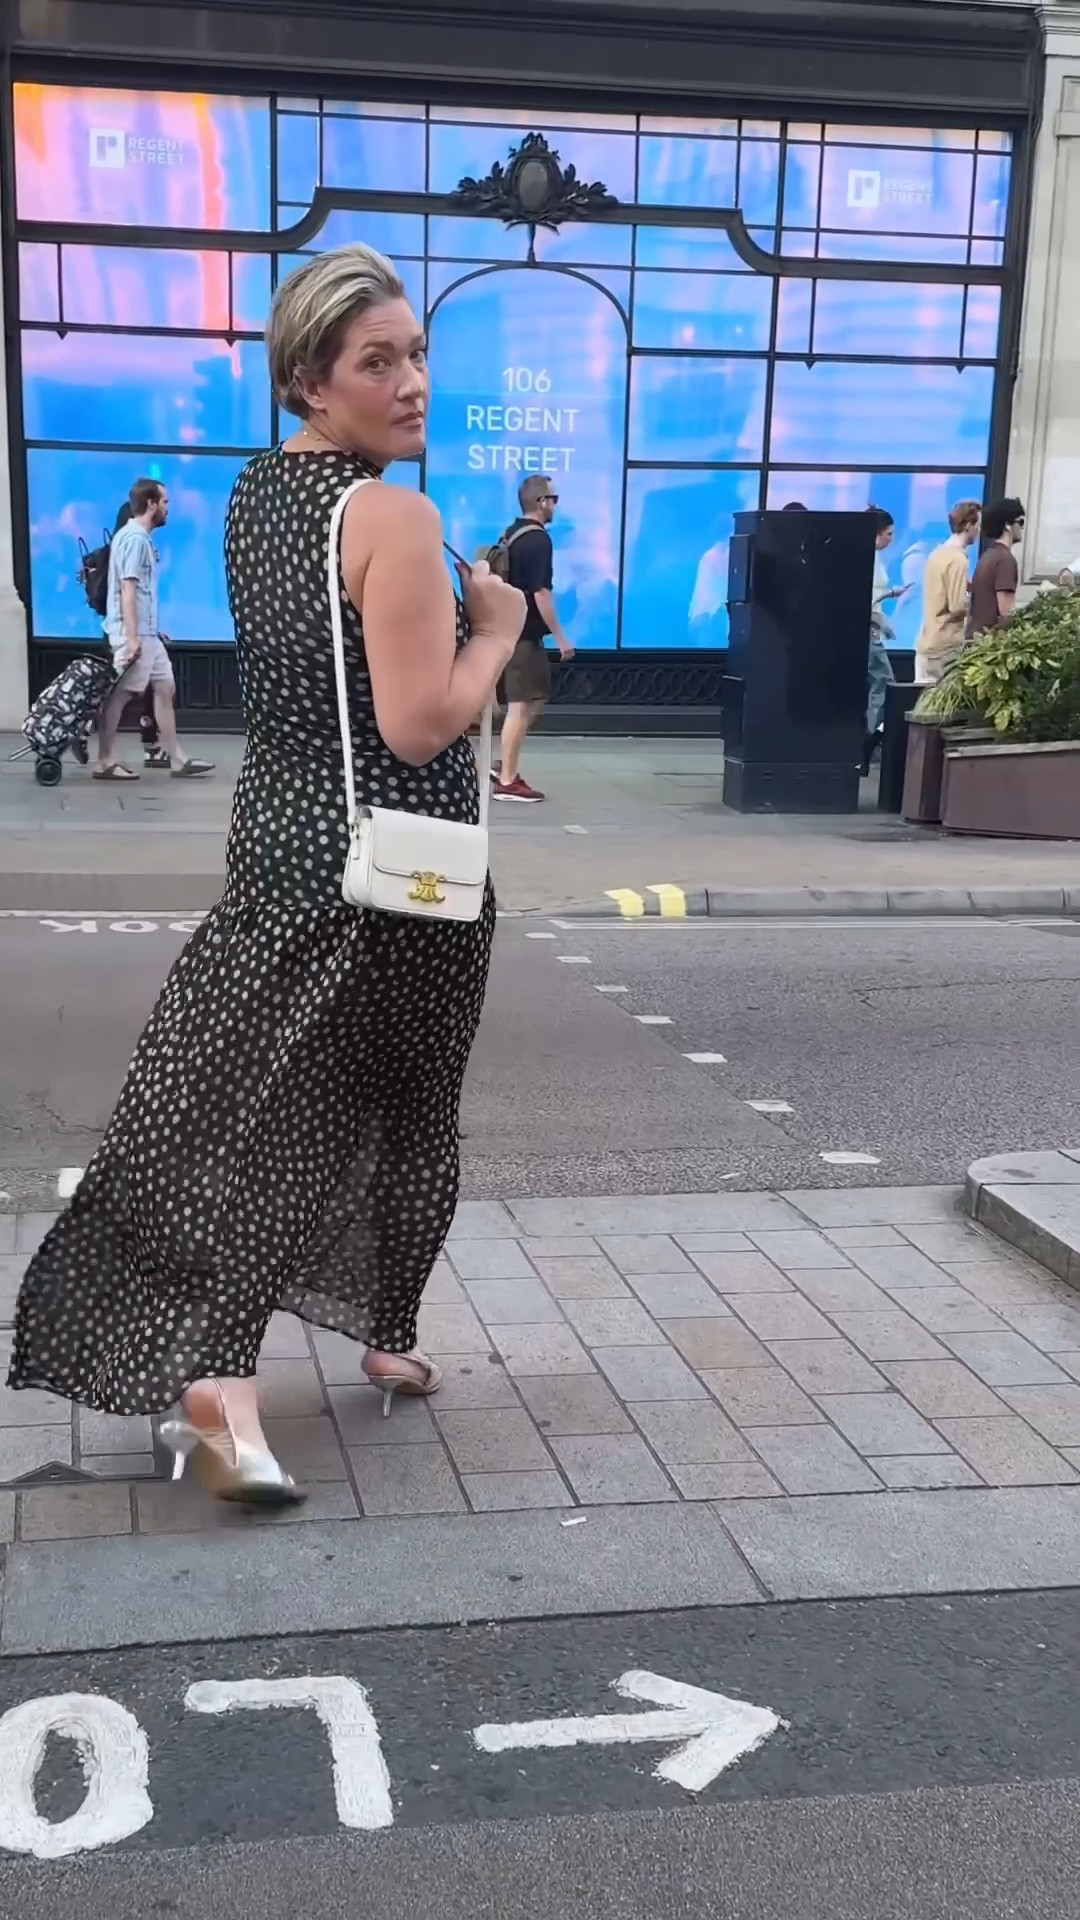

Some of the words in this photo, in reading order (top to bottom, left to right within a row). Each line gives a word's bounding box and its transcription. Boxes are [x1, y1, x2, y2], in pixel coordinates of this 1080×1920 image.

[128, 137, 185, 152] REGENT
[128, 151, 185, 165] STREET
[502, 367, 552, 394] 106
[466, 404, 582, 434] REGENT
[467, 443, 576, 473] STREET
[39, 919, 207, 934] OOK
